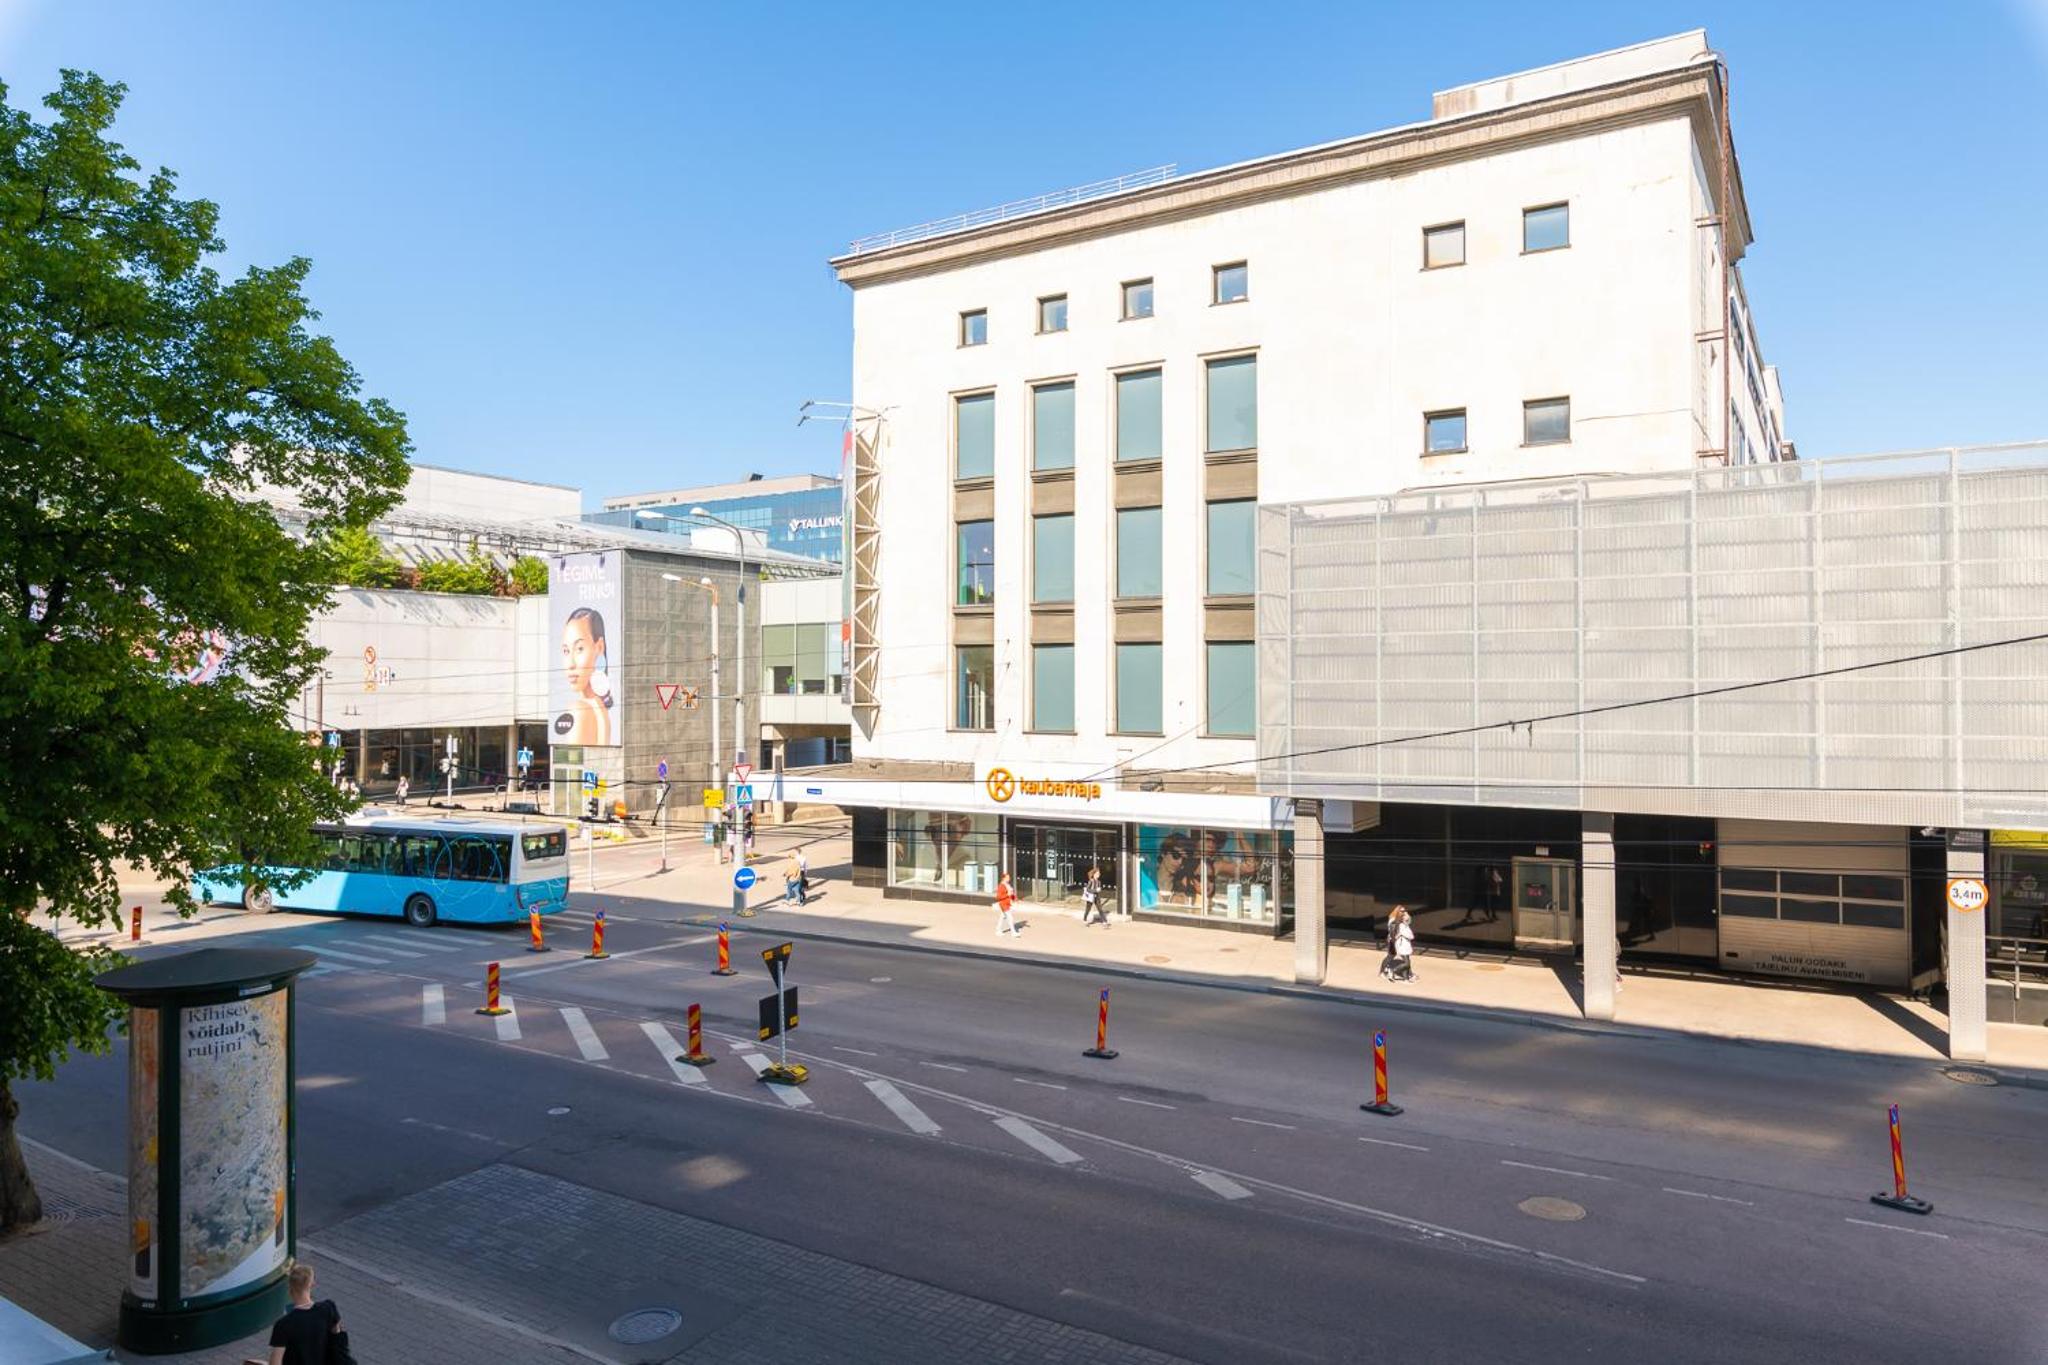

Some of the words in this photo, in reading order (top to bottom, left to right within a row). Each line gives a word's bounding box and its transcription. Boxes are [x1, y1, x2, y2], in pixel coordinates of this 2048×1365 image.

[802, 515, 843, 529] TALLINK
[554, 566, 606, 583] TEGIME
[1020, 777, 1102, 802] kaubamaja
[187, 1020, 246, 1039] võidab
